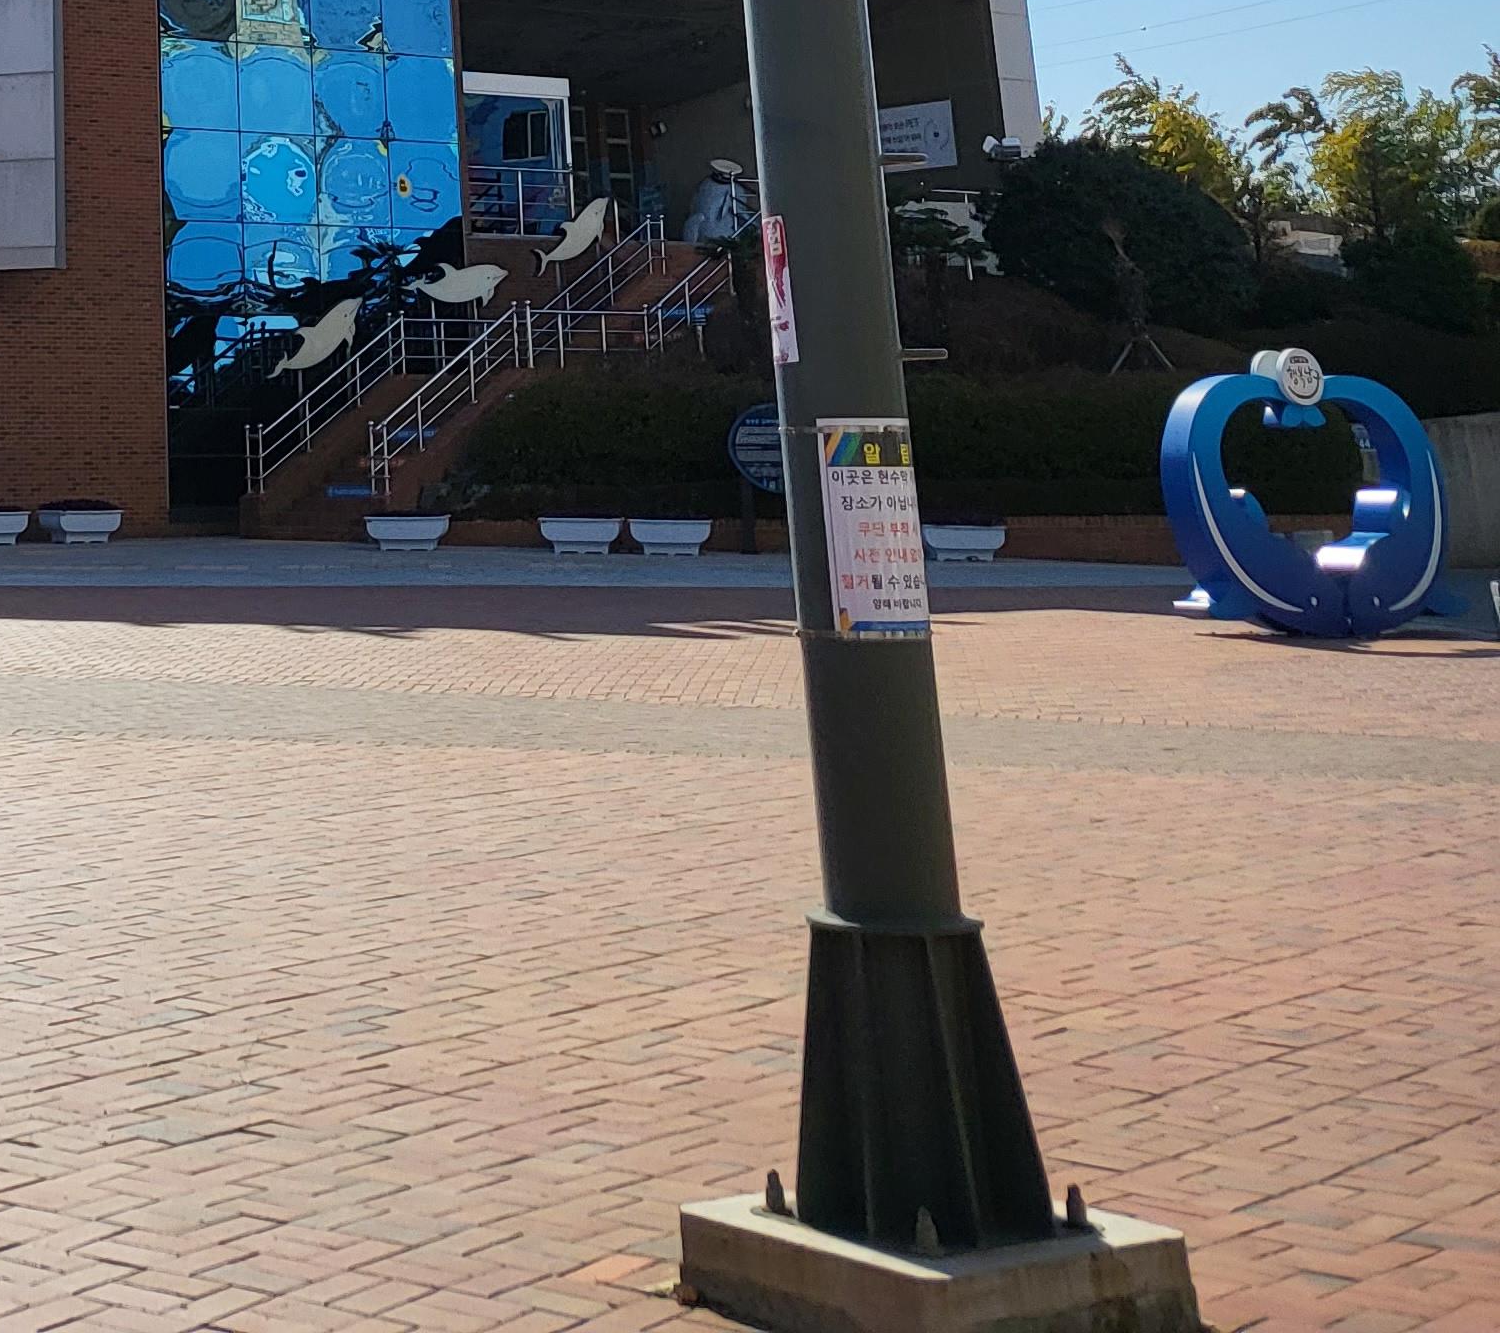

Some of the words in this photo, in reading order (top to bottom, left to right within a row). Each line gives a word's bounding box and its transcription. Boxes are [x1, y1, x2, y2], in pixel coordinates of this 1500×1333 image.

[831, 469, 874, 485] 이곳은
[841, 495, 882, 511] 장소가
[886, 495, 917, 511] 아닙니
[858, 521, 885, 537] 무단
[854, 548, 881, 563] 사전
[841, 573, 884, 590] 철거될
[887, 574, 901, 590] 수
